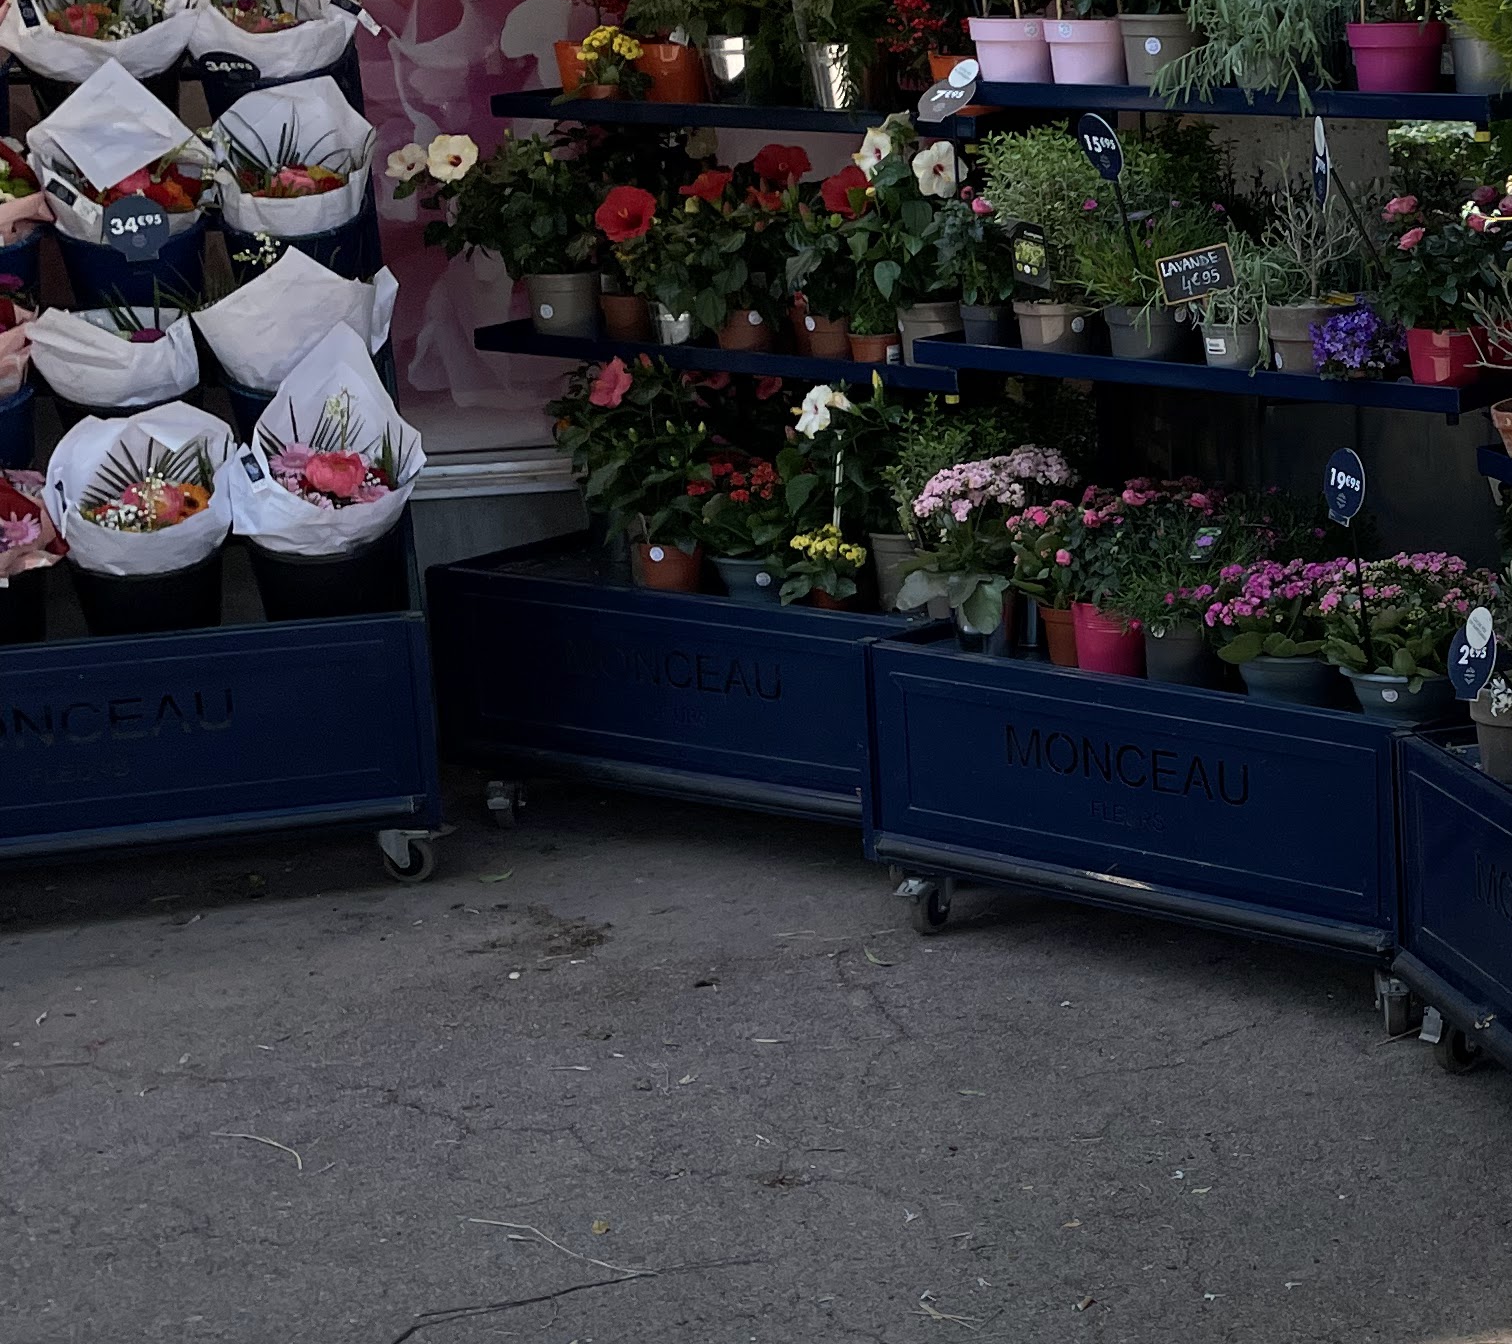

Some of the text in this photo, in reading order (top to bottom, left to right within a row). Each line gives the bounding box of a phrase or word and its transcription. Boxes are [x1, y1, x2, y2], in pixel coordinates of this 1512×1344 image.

[205, 61, 253, 72] 34€95
[930, 89, 965, 102] 7€95
[1083, 134, 1116, 153] 15€95
[110, 213, 162, 235] 34€95
[1160, 250, 1218, 278] LAVANDE
[1181, 268, 1221, 296] 4€95
[1330, 467, 1361, 492] 19€95
[1005, 723, 1250, 806] MONCEAU
